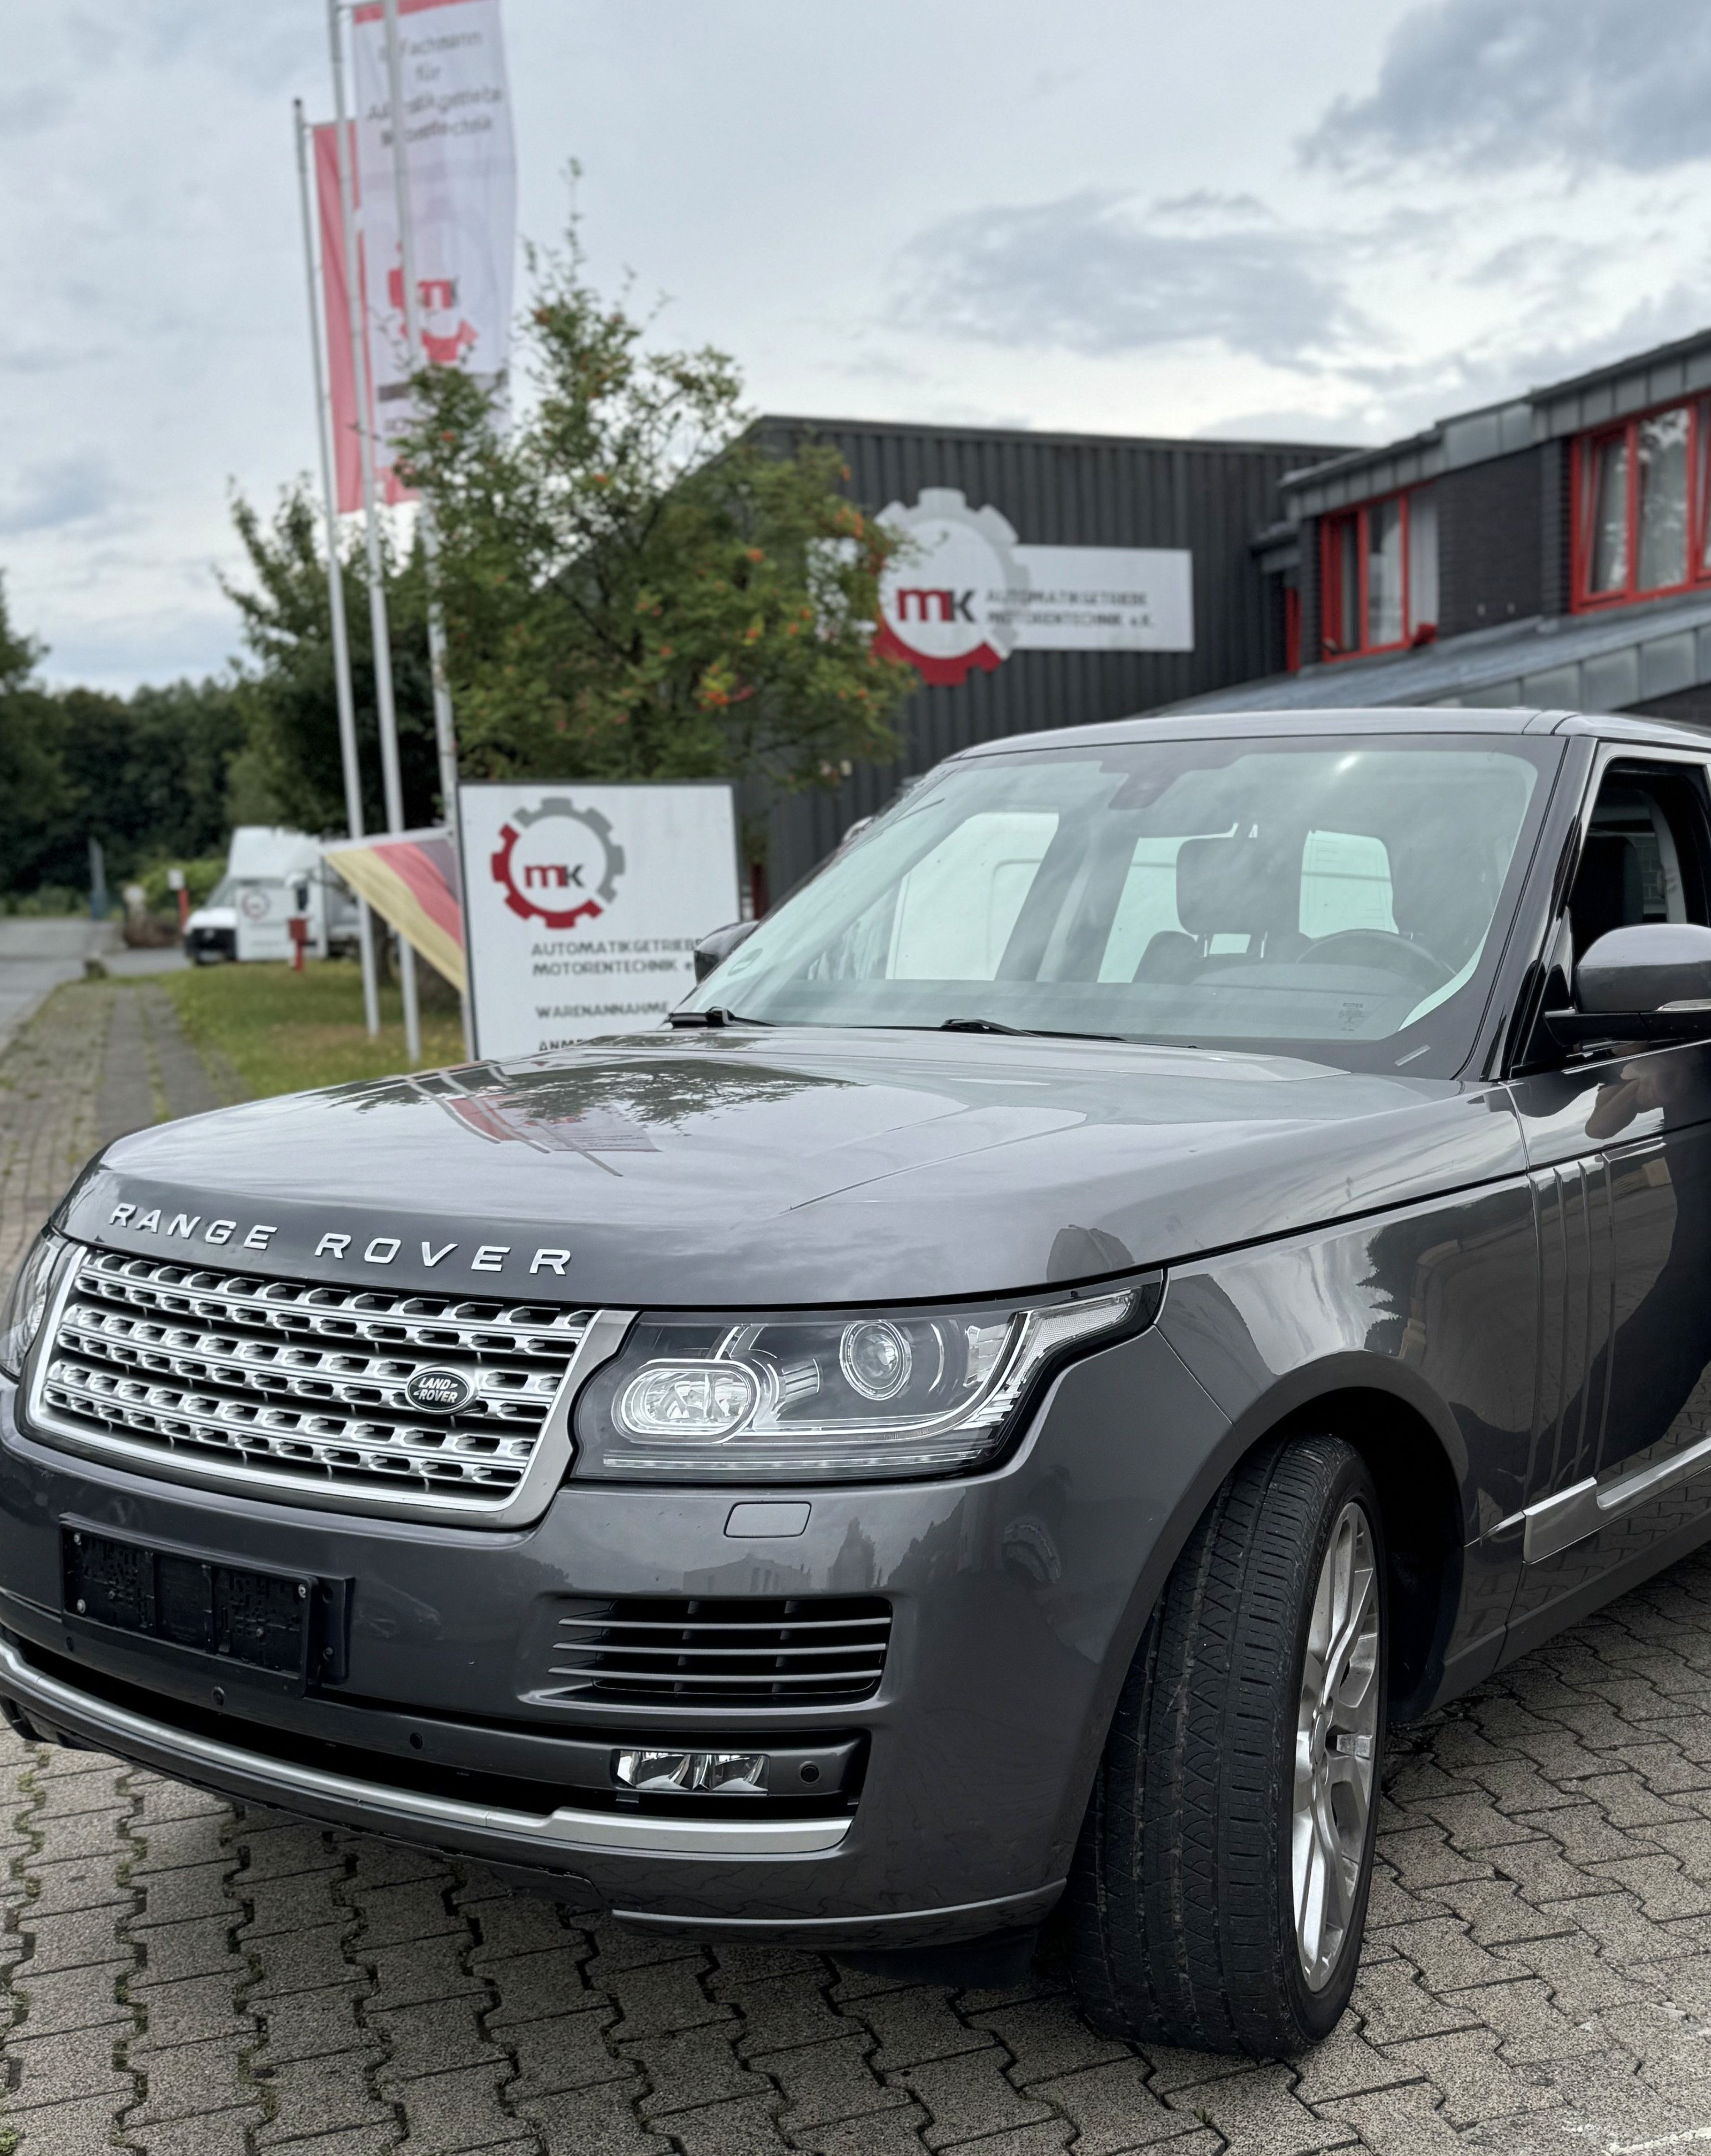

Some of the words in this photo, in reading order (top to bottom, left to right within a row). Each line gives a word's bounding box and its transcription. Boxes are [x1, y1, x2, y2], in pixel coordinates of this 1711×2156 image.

[109, 1202, 278, 1250] RANGE
[314, 1232, 571, 1275] ROVER
[418, 1377, 451, 1389] LAND
[418, 1388, 458, 1403] ROVER
